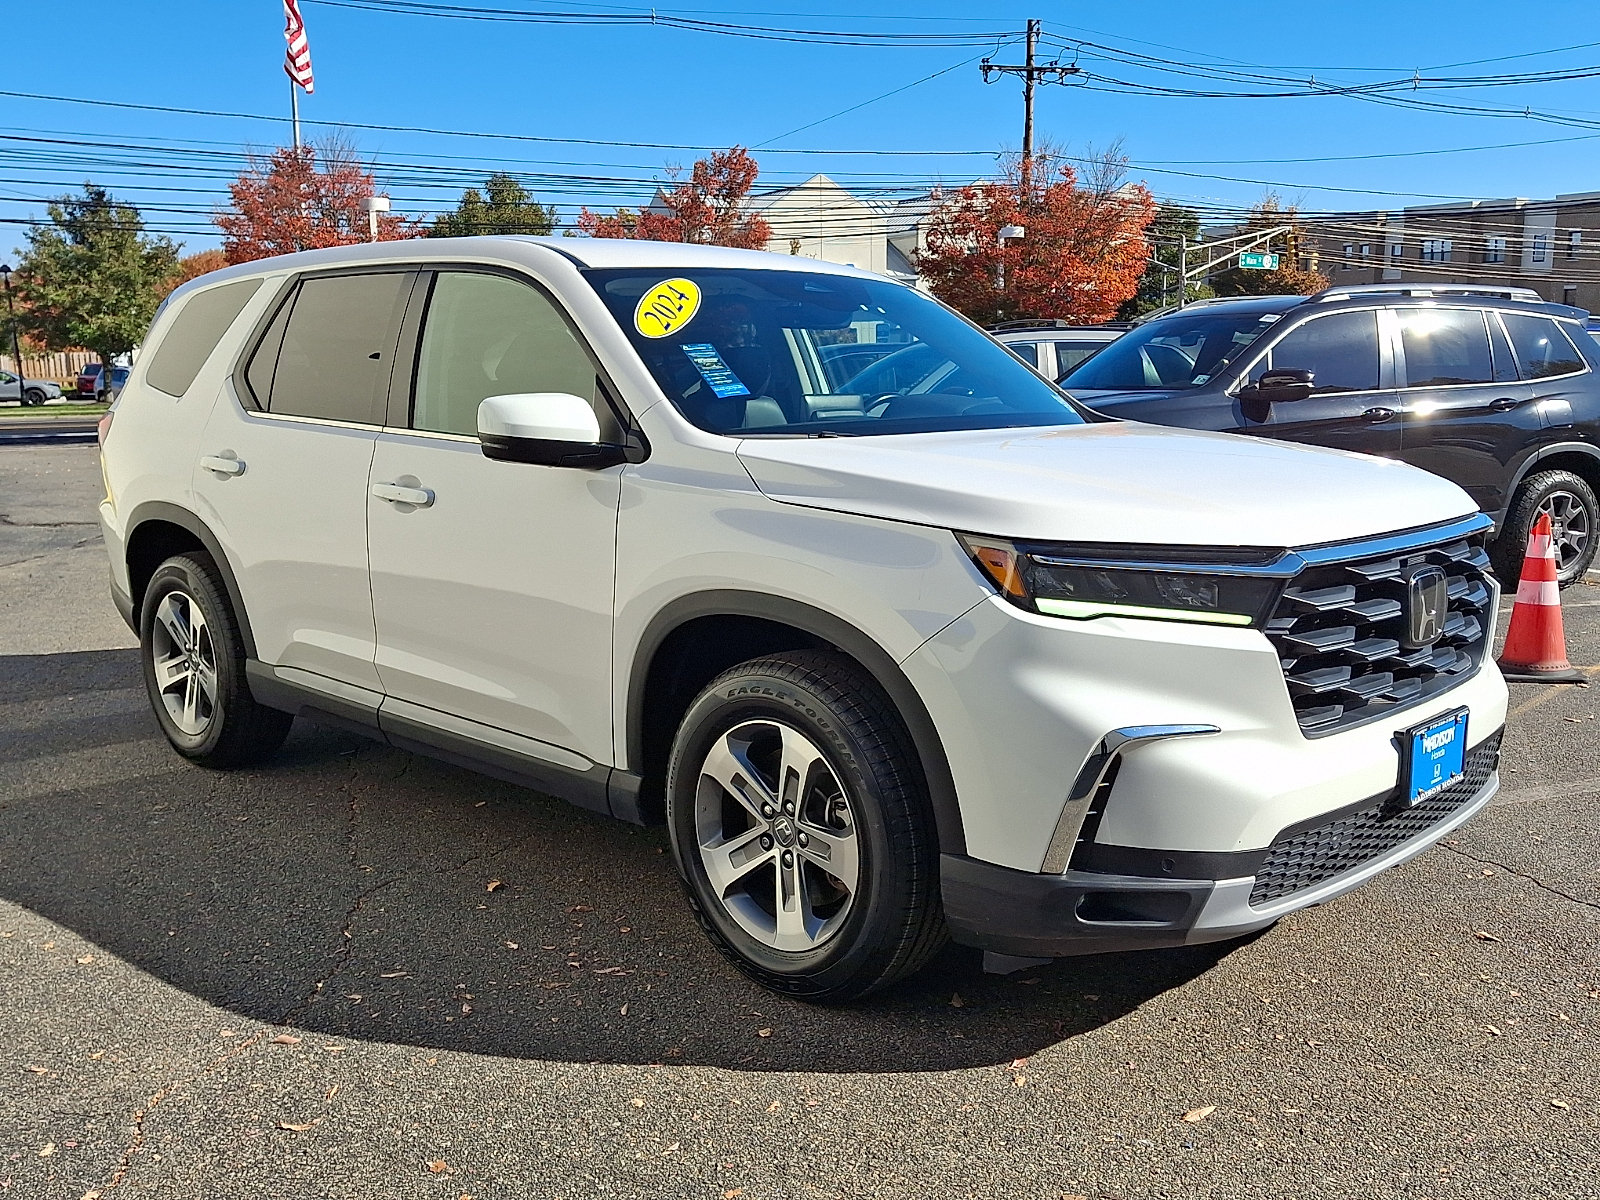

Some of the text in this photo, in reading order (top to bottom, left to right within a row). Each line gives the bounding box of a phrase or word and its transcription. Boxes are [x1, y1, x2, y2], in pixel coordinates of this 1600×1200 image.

[644, 284, 690, 332] 2024
[727, 687, 868, 792] EAGLE TOURING
[1422, 726, 1456, 755] MADISON
[1430, 747, 1446, 761] Honda
